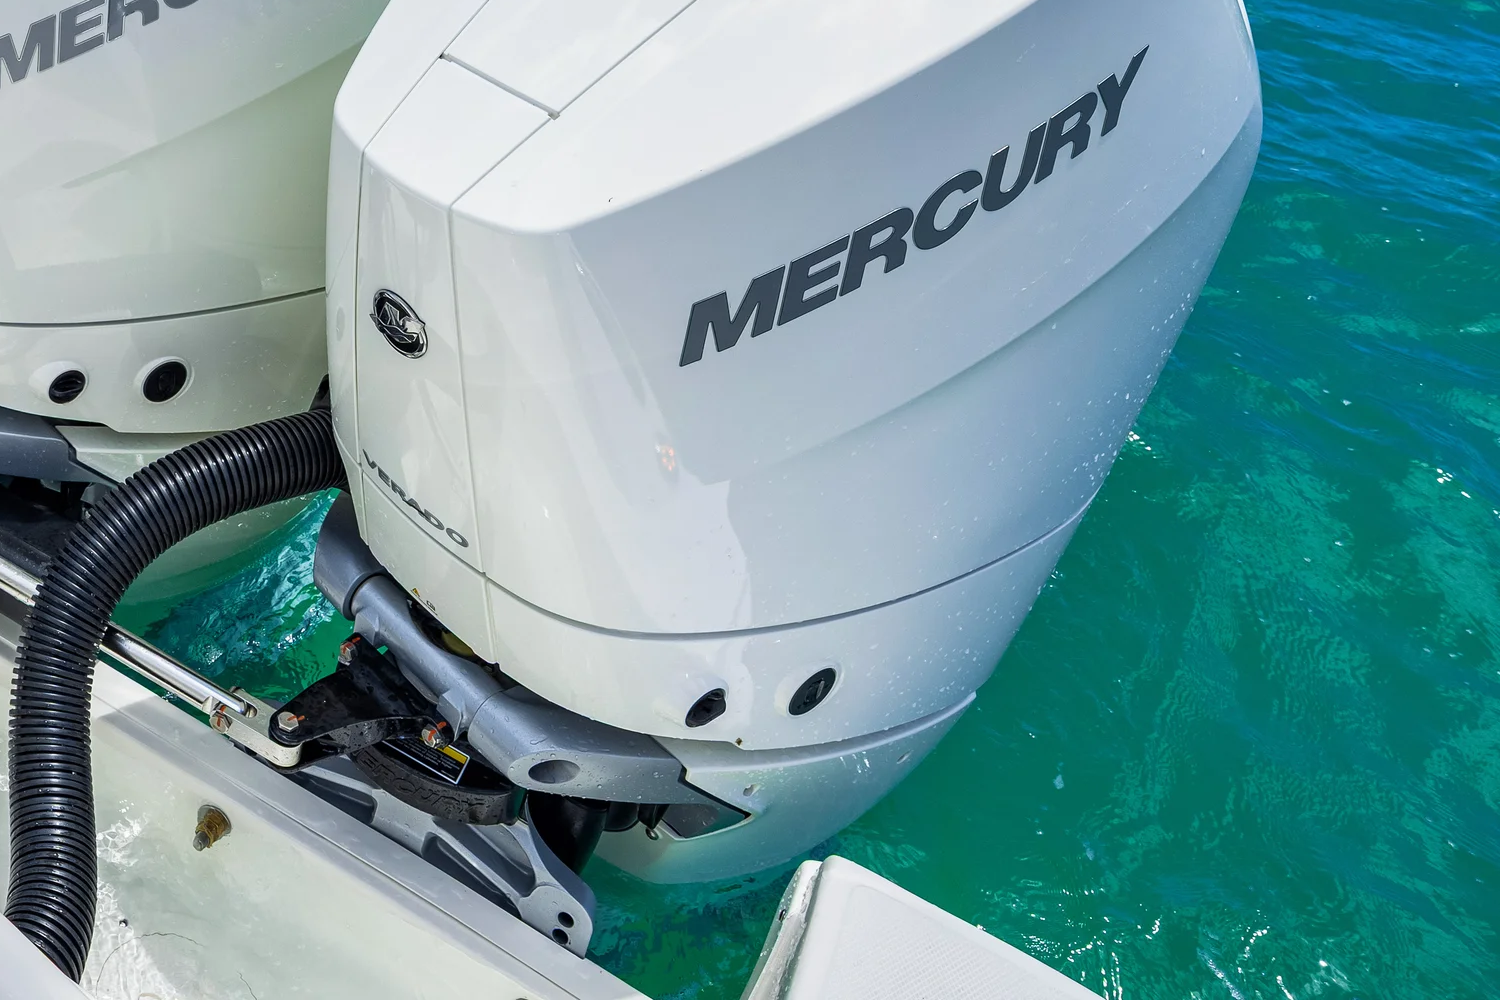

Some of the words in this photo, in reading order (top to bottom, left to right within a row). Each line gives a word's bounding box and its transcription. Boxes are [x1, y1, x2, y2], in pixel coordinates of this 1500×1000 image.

[678, 43, 1150, 368] MERCURY
[362, 448, 469, 548] VERADO
[354, 749, 485, 813] ERCURY
